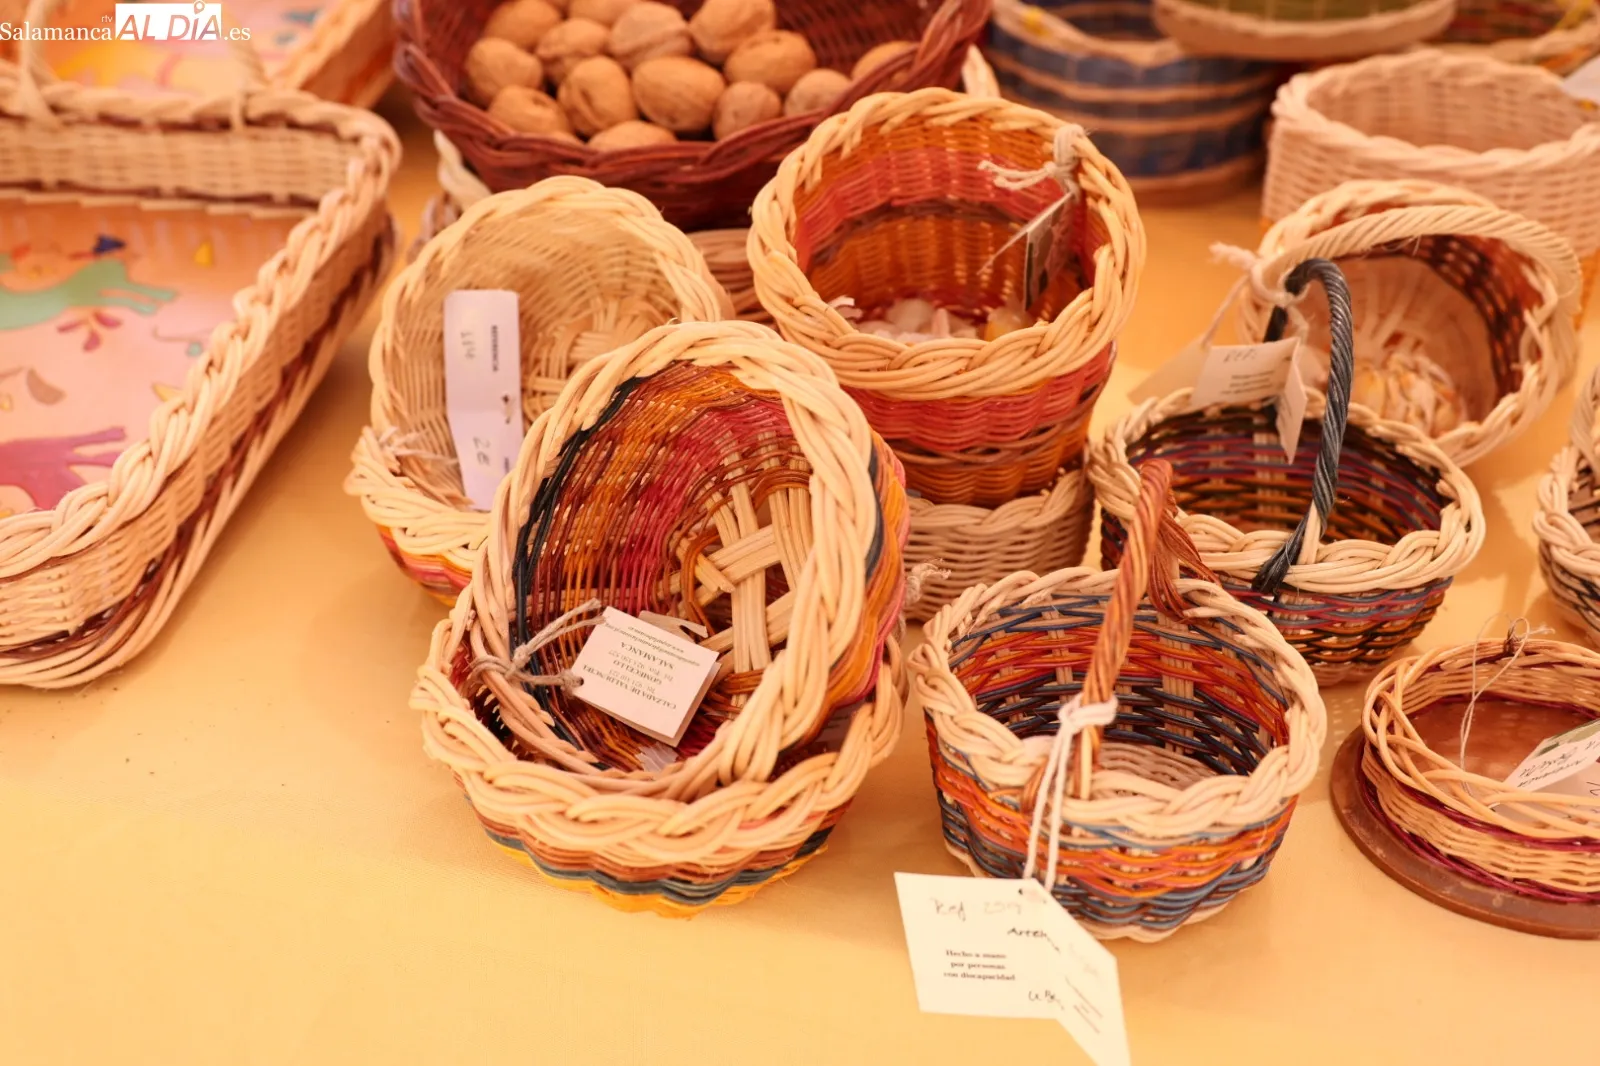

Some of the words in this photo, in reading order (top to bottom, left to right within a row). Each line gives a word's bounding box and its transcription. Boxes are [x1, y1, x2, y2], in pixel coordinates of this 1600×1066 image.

[620, 641, 675, 670] SALAMANCA
[613, 660, 662, 685] GOMECELLO
[630, 686, 641, 696] DE
[642, 690, 678, 711] CALZADA
[946, 949, 973, 959] Hecho
[982, 952, 1008, 960] mano
[950, 961, 965, 969] por
[967, 962, 1007, 971] personas
[960, 971, 1016, 982] discapacidad
